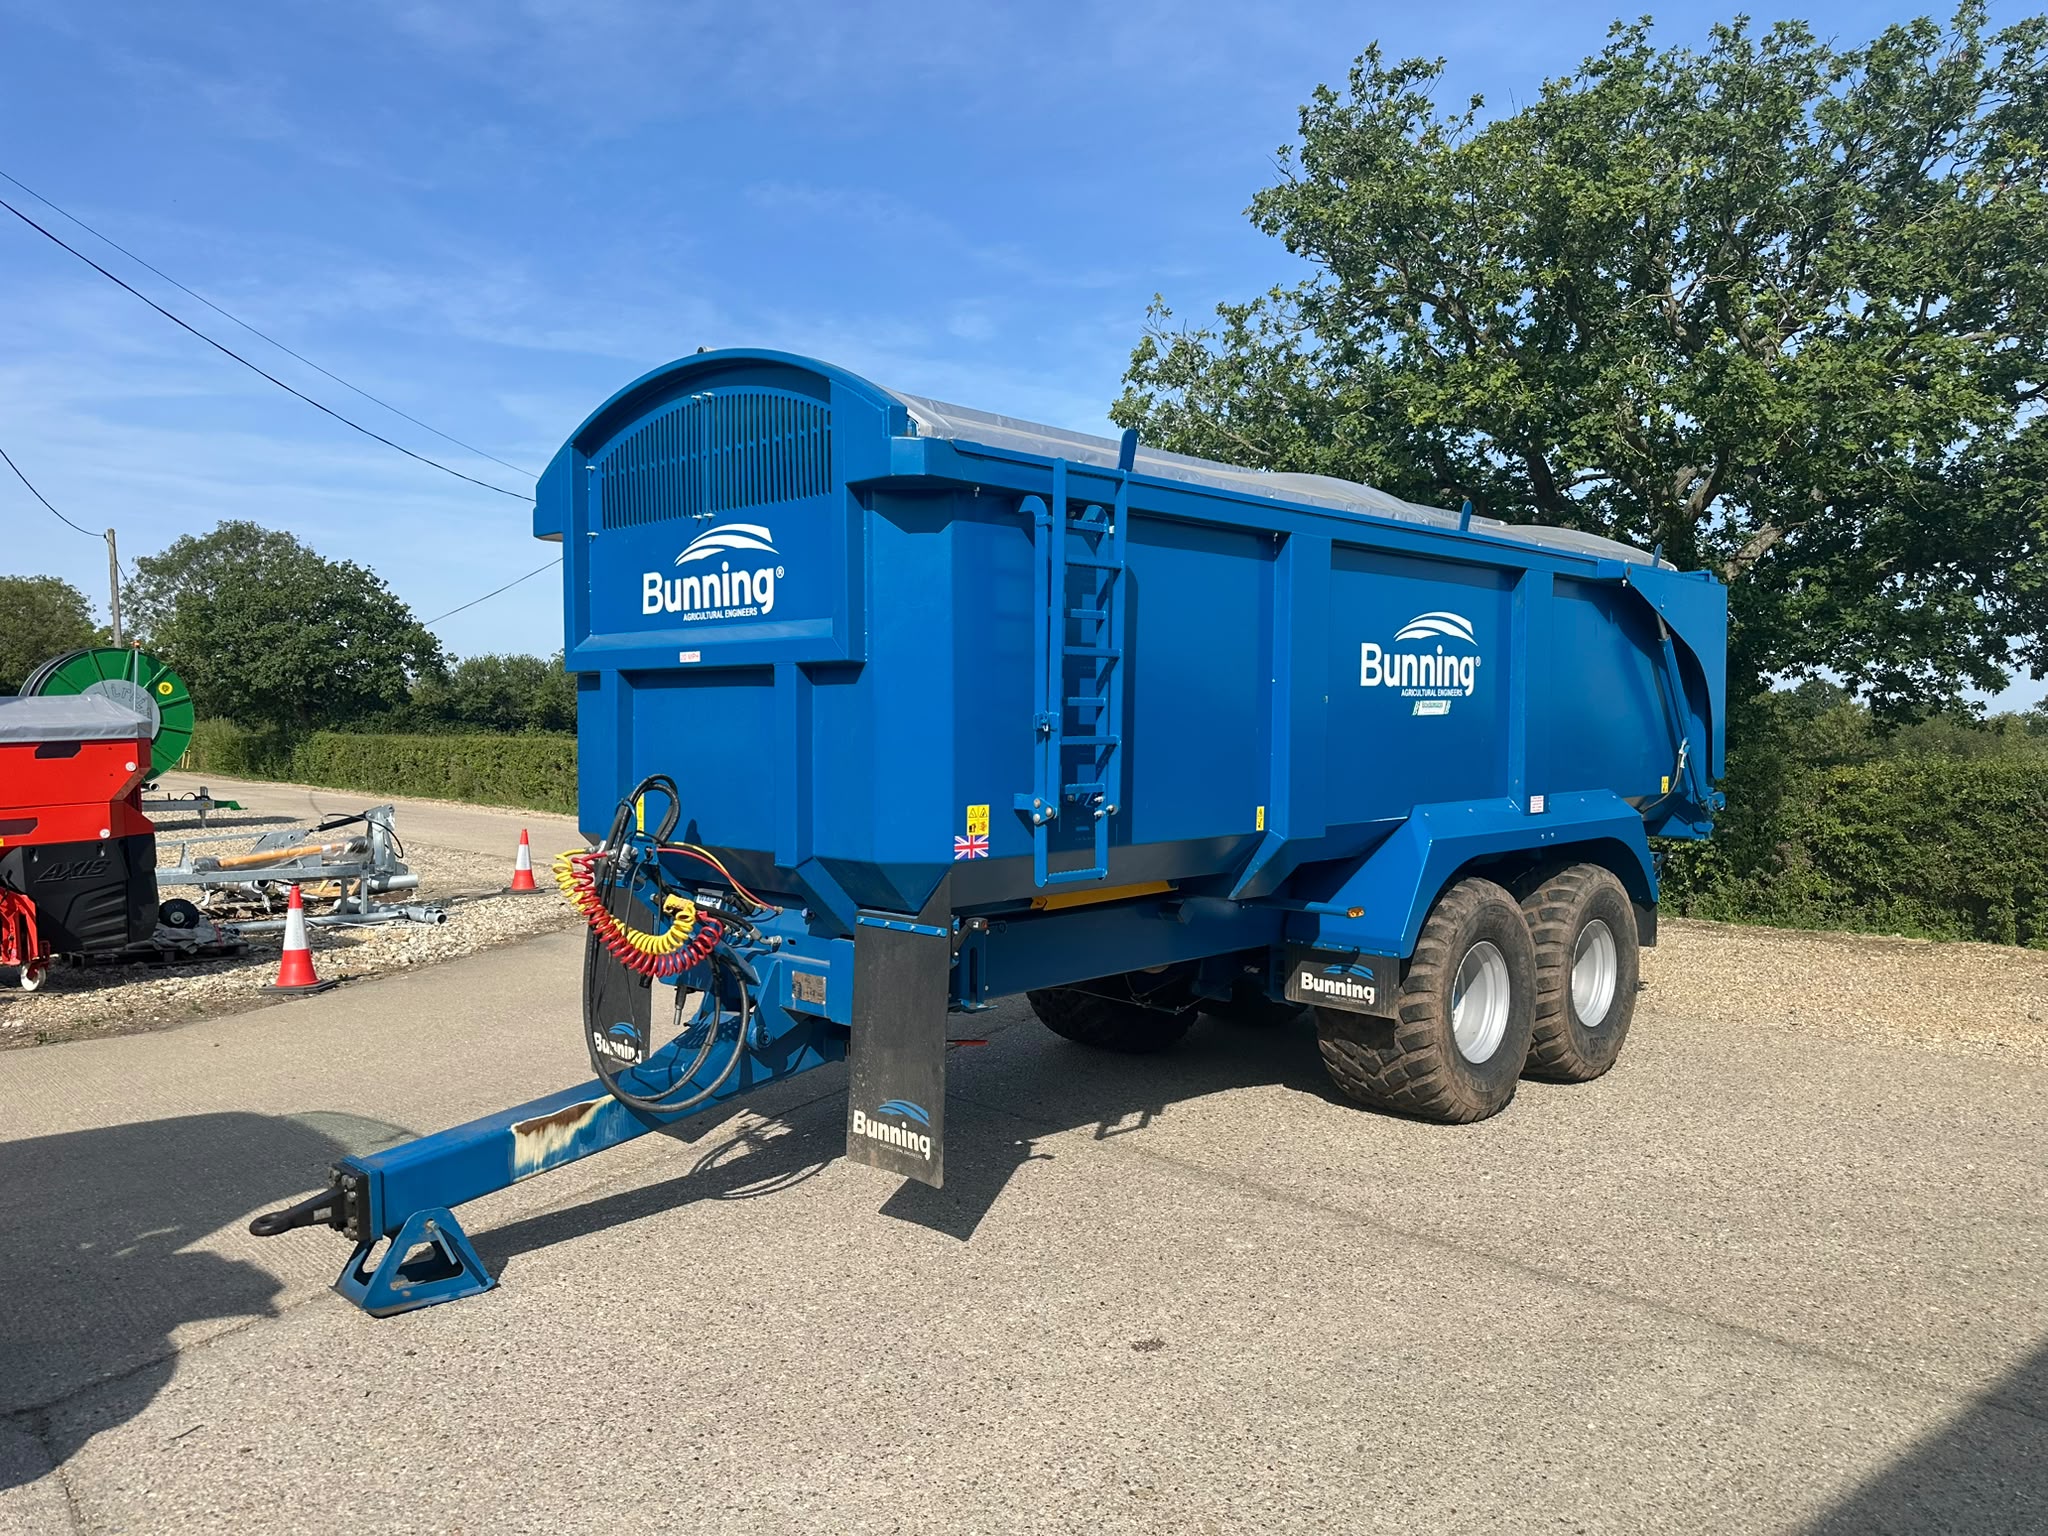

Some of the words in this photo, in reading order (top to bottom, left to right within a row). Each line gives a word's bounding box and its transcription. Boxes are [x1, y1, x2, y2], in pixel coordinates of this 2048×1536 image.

[642, 561, 775, 615] Bunning
[682, 610, 724, 622] AGRICULTURAL
[724, 606, 758, 619] ENGINEERS
[1360, 642, 1475, 697] Bunning
[1401, 688, 1437, 697] AGRICULTURAL
[1437, 688, 1463, 697] ENGINEERS
[38, 859, 111, 881] AXIS
[1301, 971, 1375, 1005] Bunning
[853, 1109, 931, 1161] Bunning
